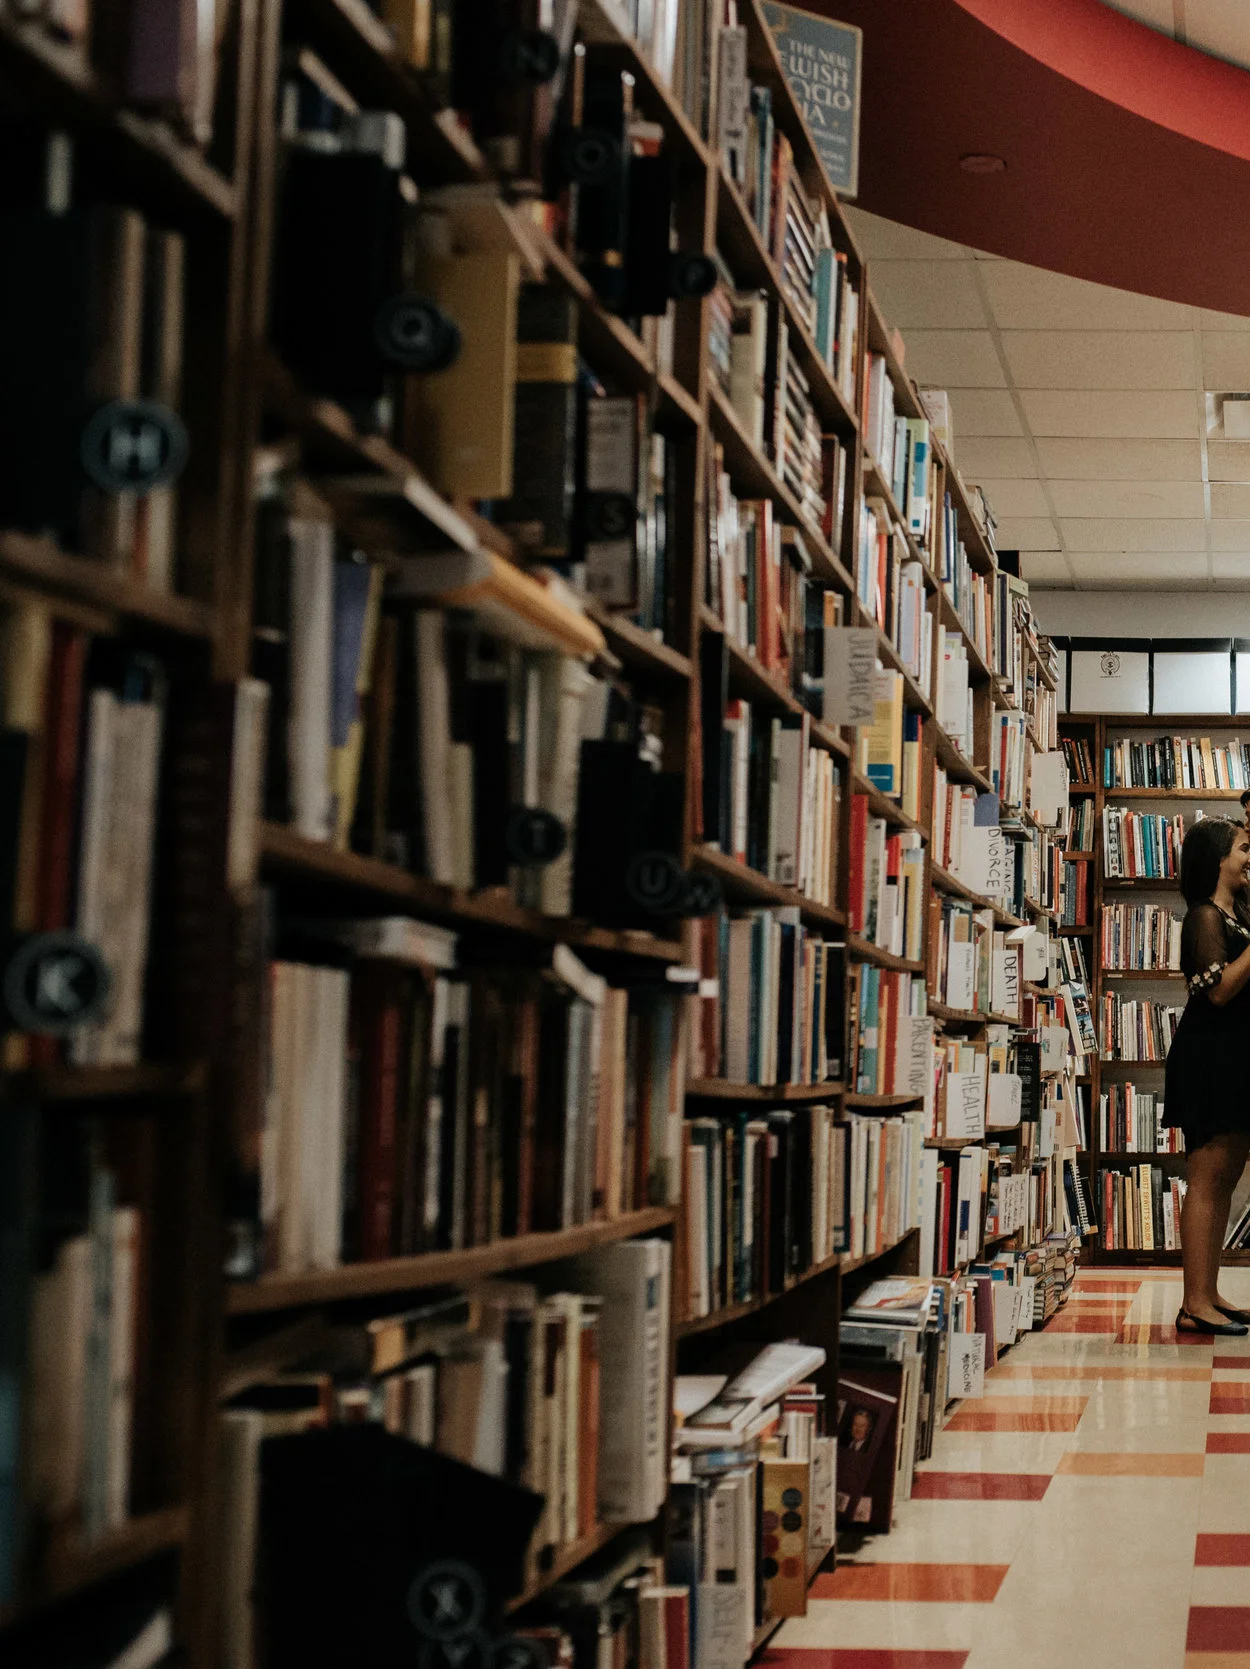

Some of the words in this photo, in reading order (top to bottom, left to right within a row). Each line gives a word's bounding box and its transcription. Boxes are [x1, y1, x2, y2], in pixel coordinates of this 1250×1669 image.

[986, 828, 1002, 889] DIVORCE
[1003, 956, 1018, 1005] DEATH
[908, 1018, 931, 1095] PARENTING
[961, 1076, 982, 1135] HEALTH
[961, 1353, 973, 1393] MEDICINE
